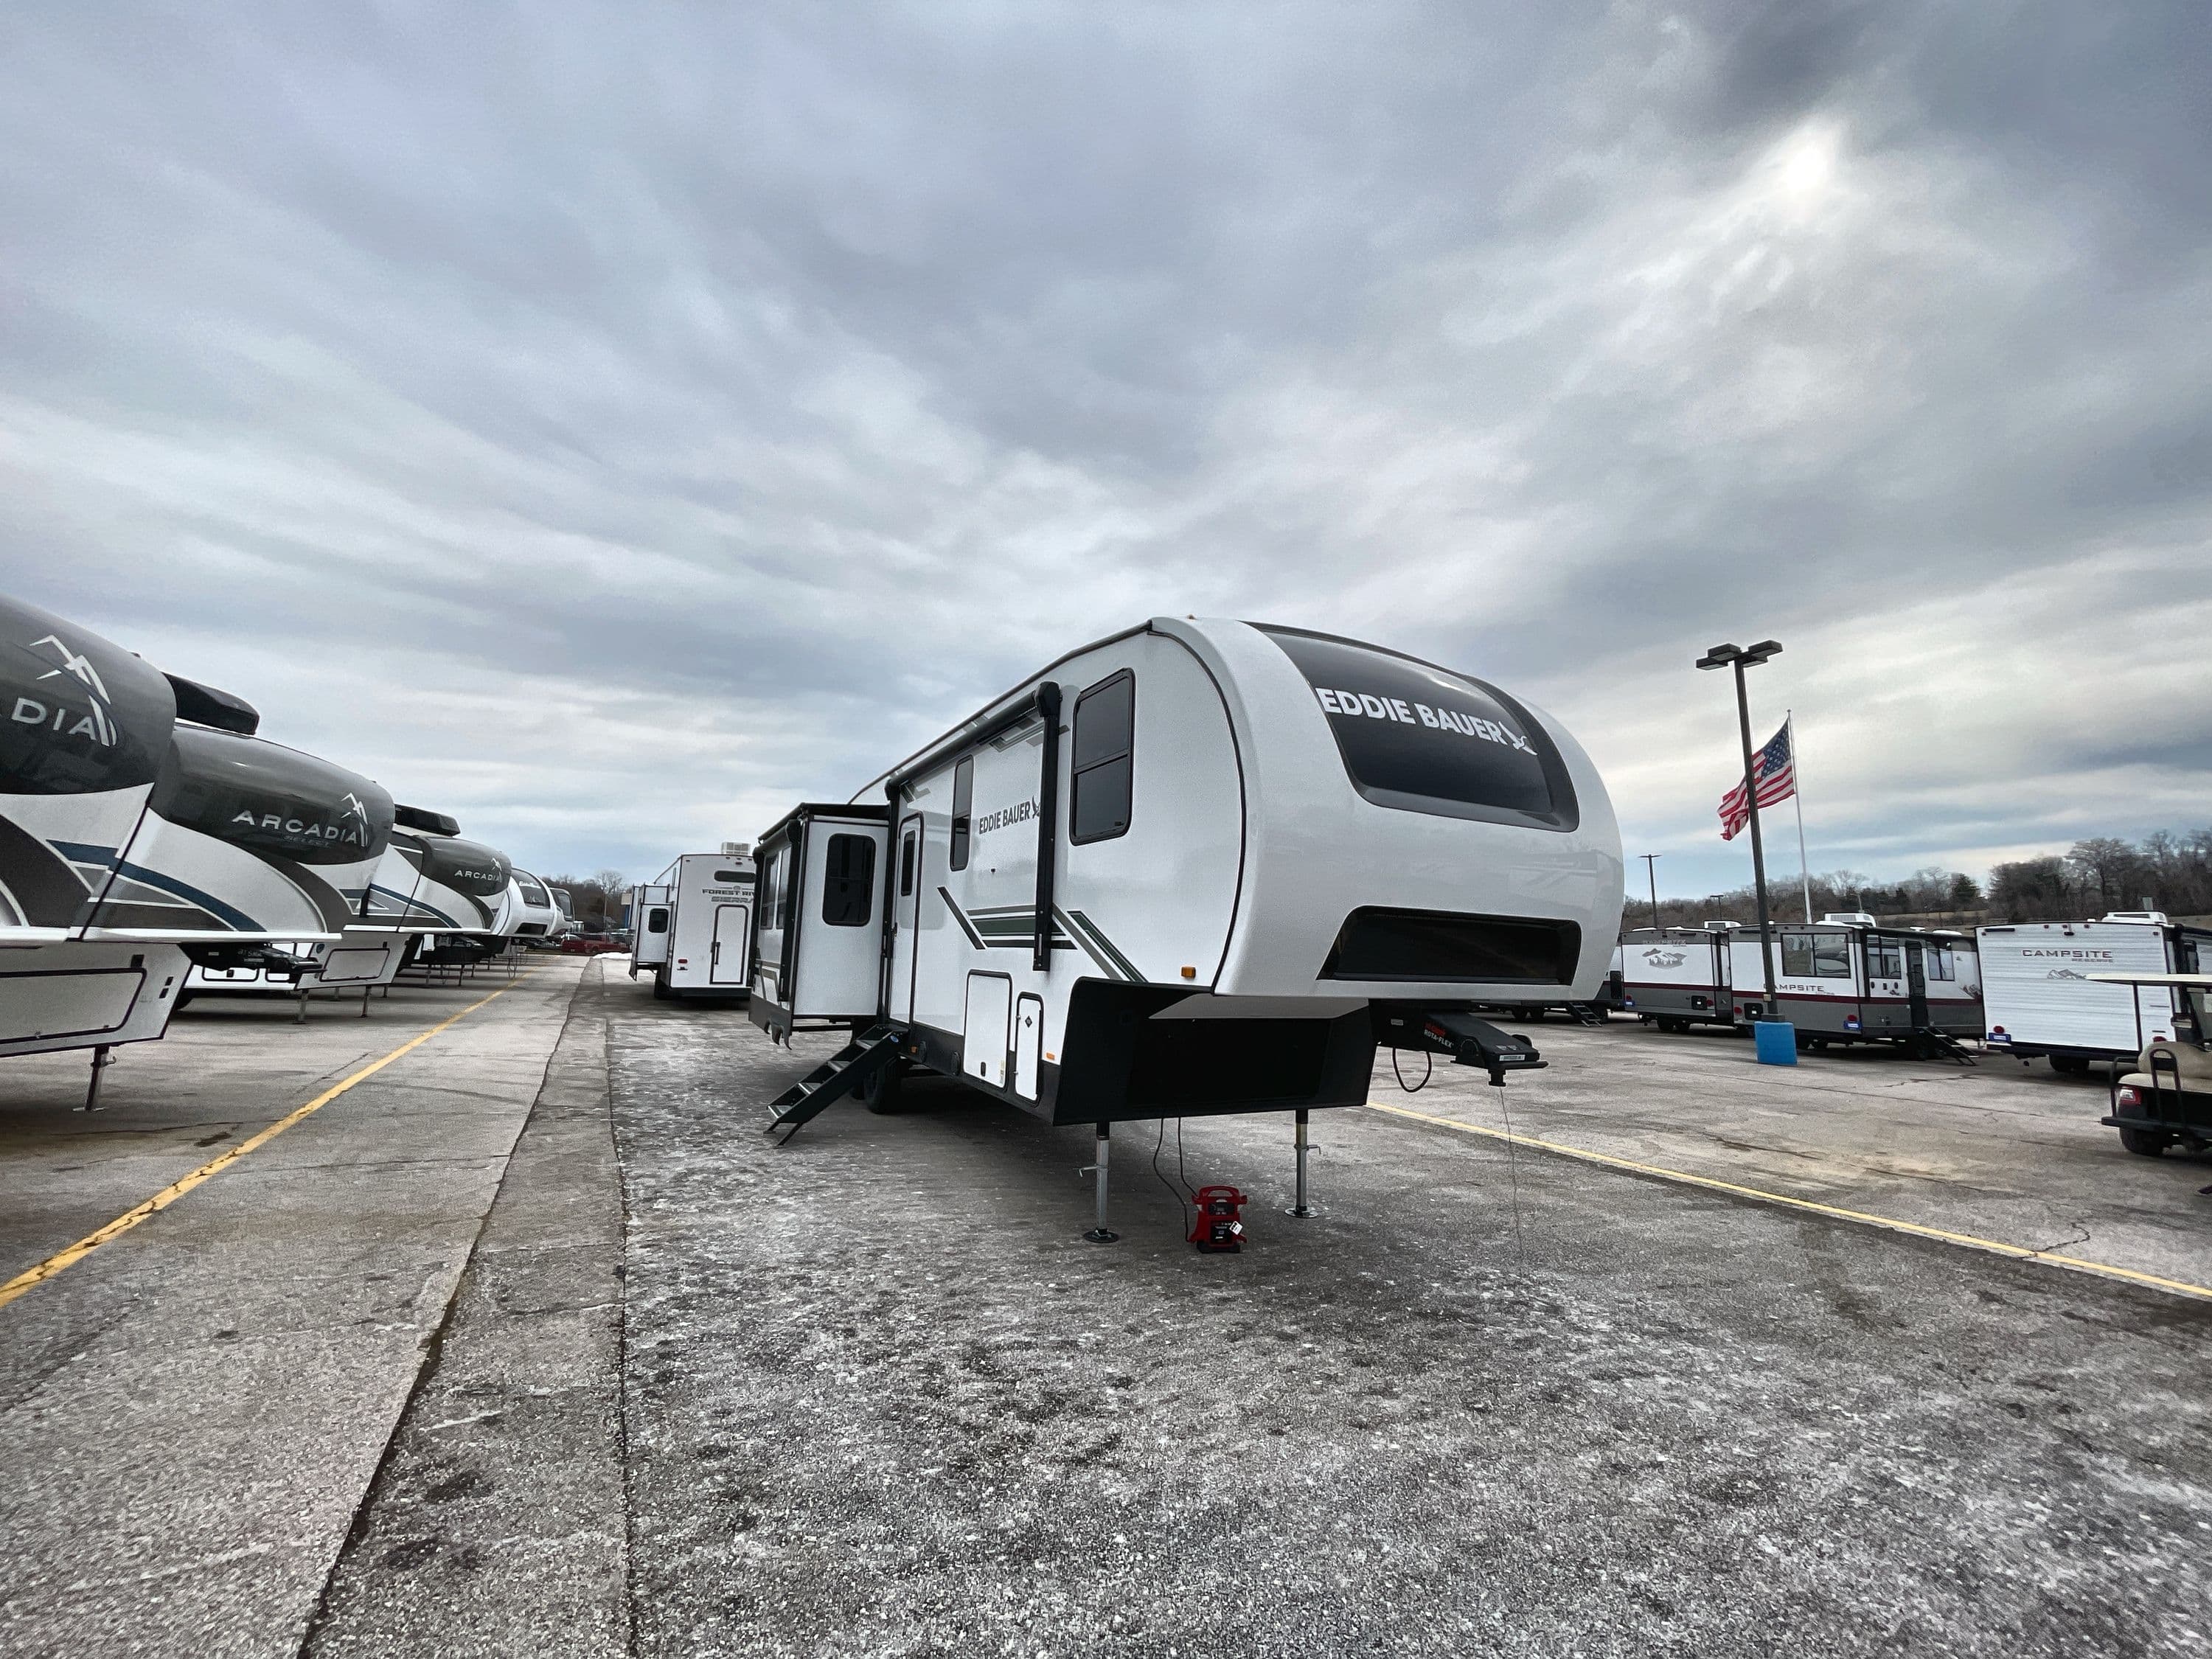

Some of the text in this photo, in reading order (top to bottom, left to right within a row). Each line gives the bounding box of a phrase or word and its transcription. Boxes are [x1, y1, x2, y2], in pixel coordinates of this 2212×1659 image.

[1315, 687, 1508, 745] EDDIE BAUER
[232, 810, 358, 844] ARCADIA
[978, 801, 1030, 835] EDDIE BAUER
[454, 870, 500, 881] ARCADIA
[2023, 950, 2112, 959] CAMPSITE
[1763, 984, 1825, 992] MPSITE
